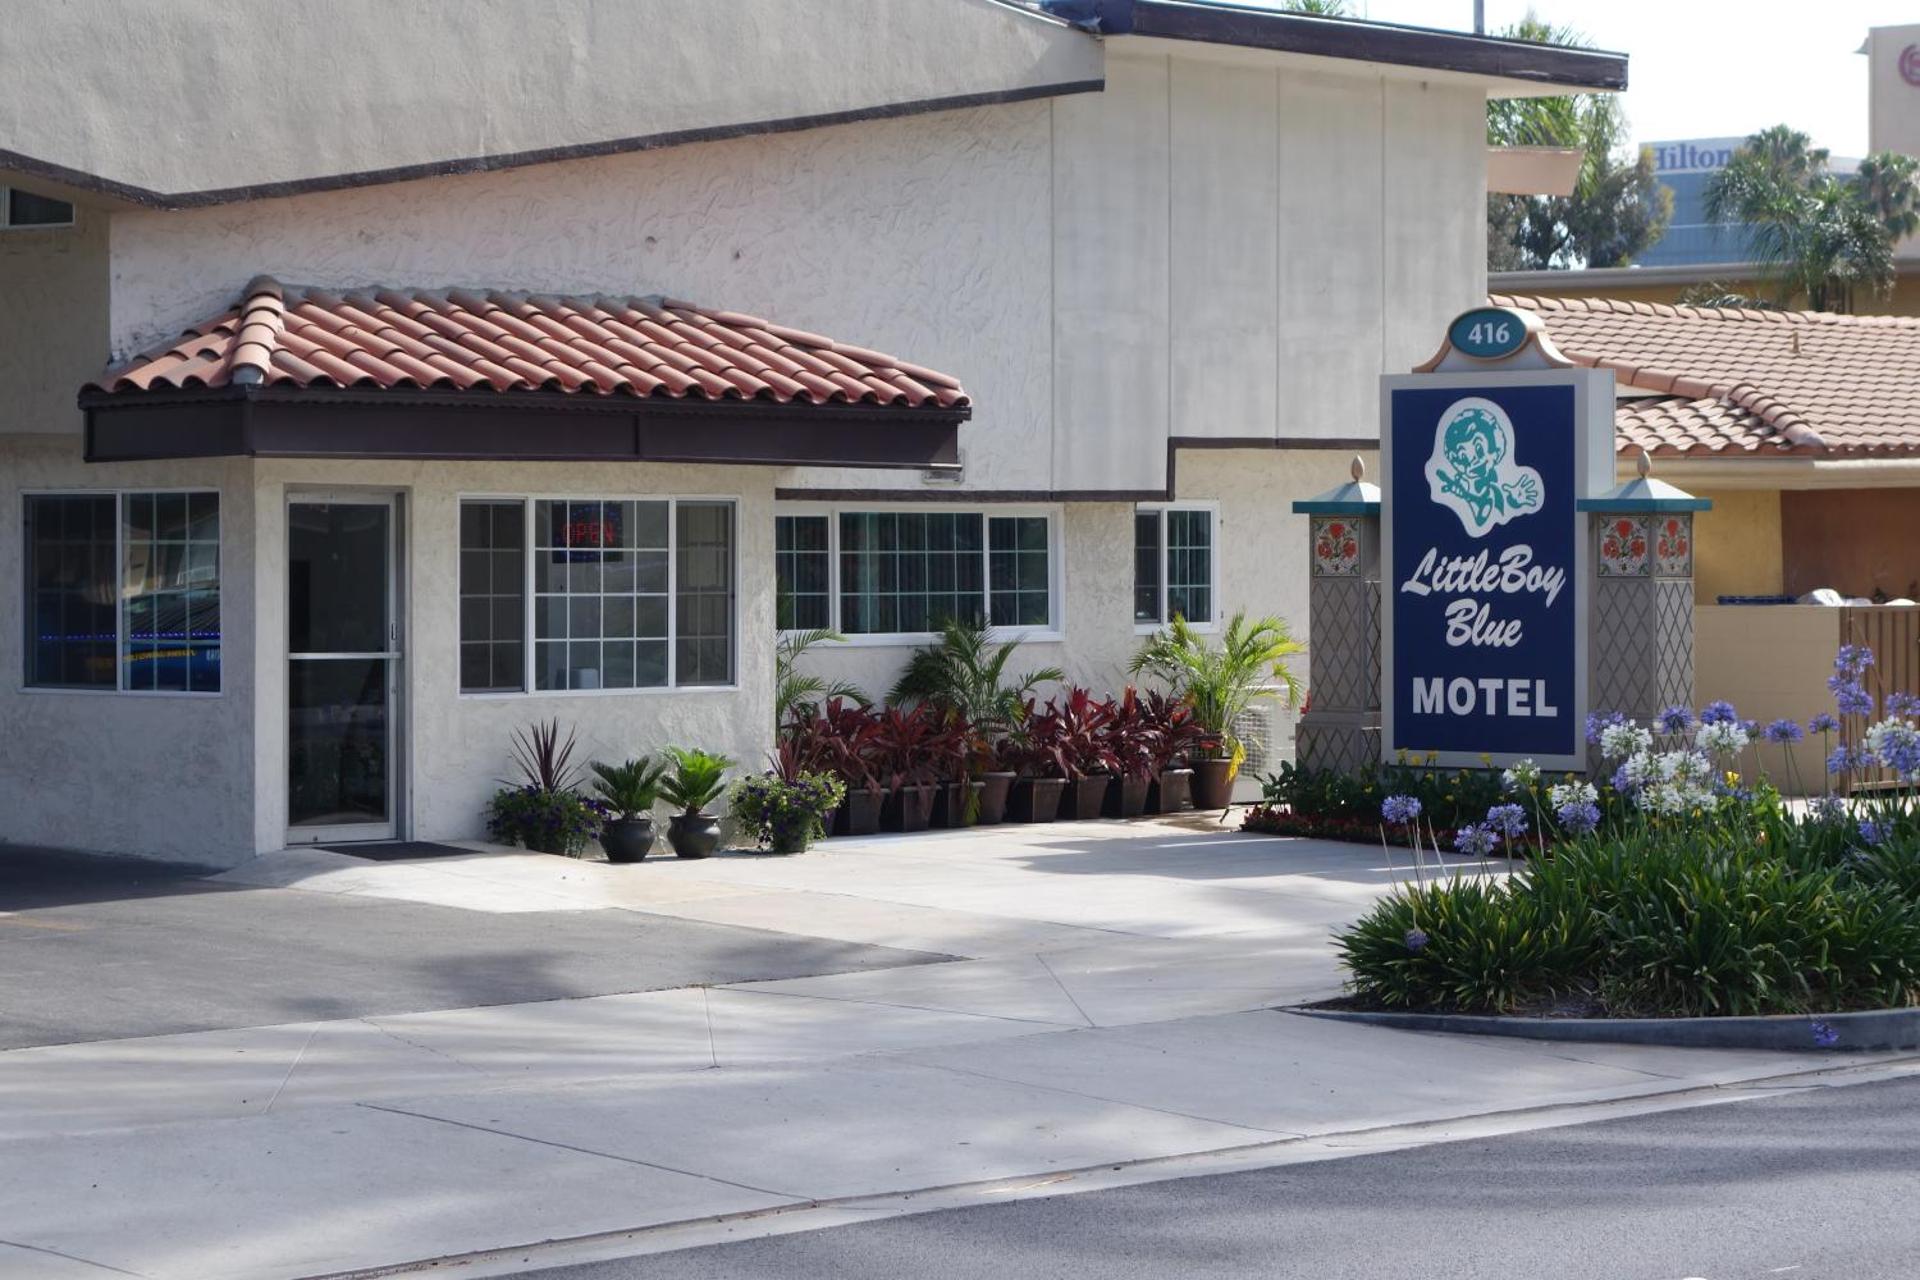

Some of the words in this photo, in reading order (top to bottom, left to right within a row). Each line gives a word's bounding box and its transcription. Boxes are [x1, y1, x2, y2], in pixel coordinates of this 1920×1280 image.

[1468, 322, 1510, 345] 416
[1445, 598, 1523, 648] Blue
[1412, 677, 1558, 717] MOTEL
